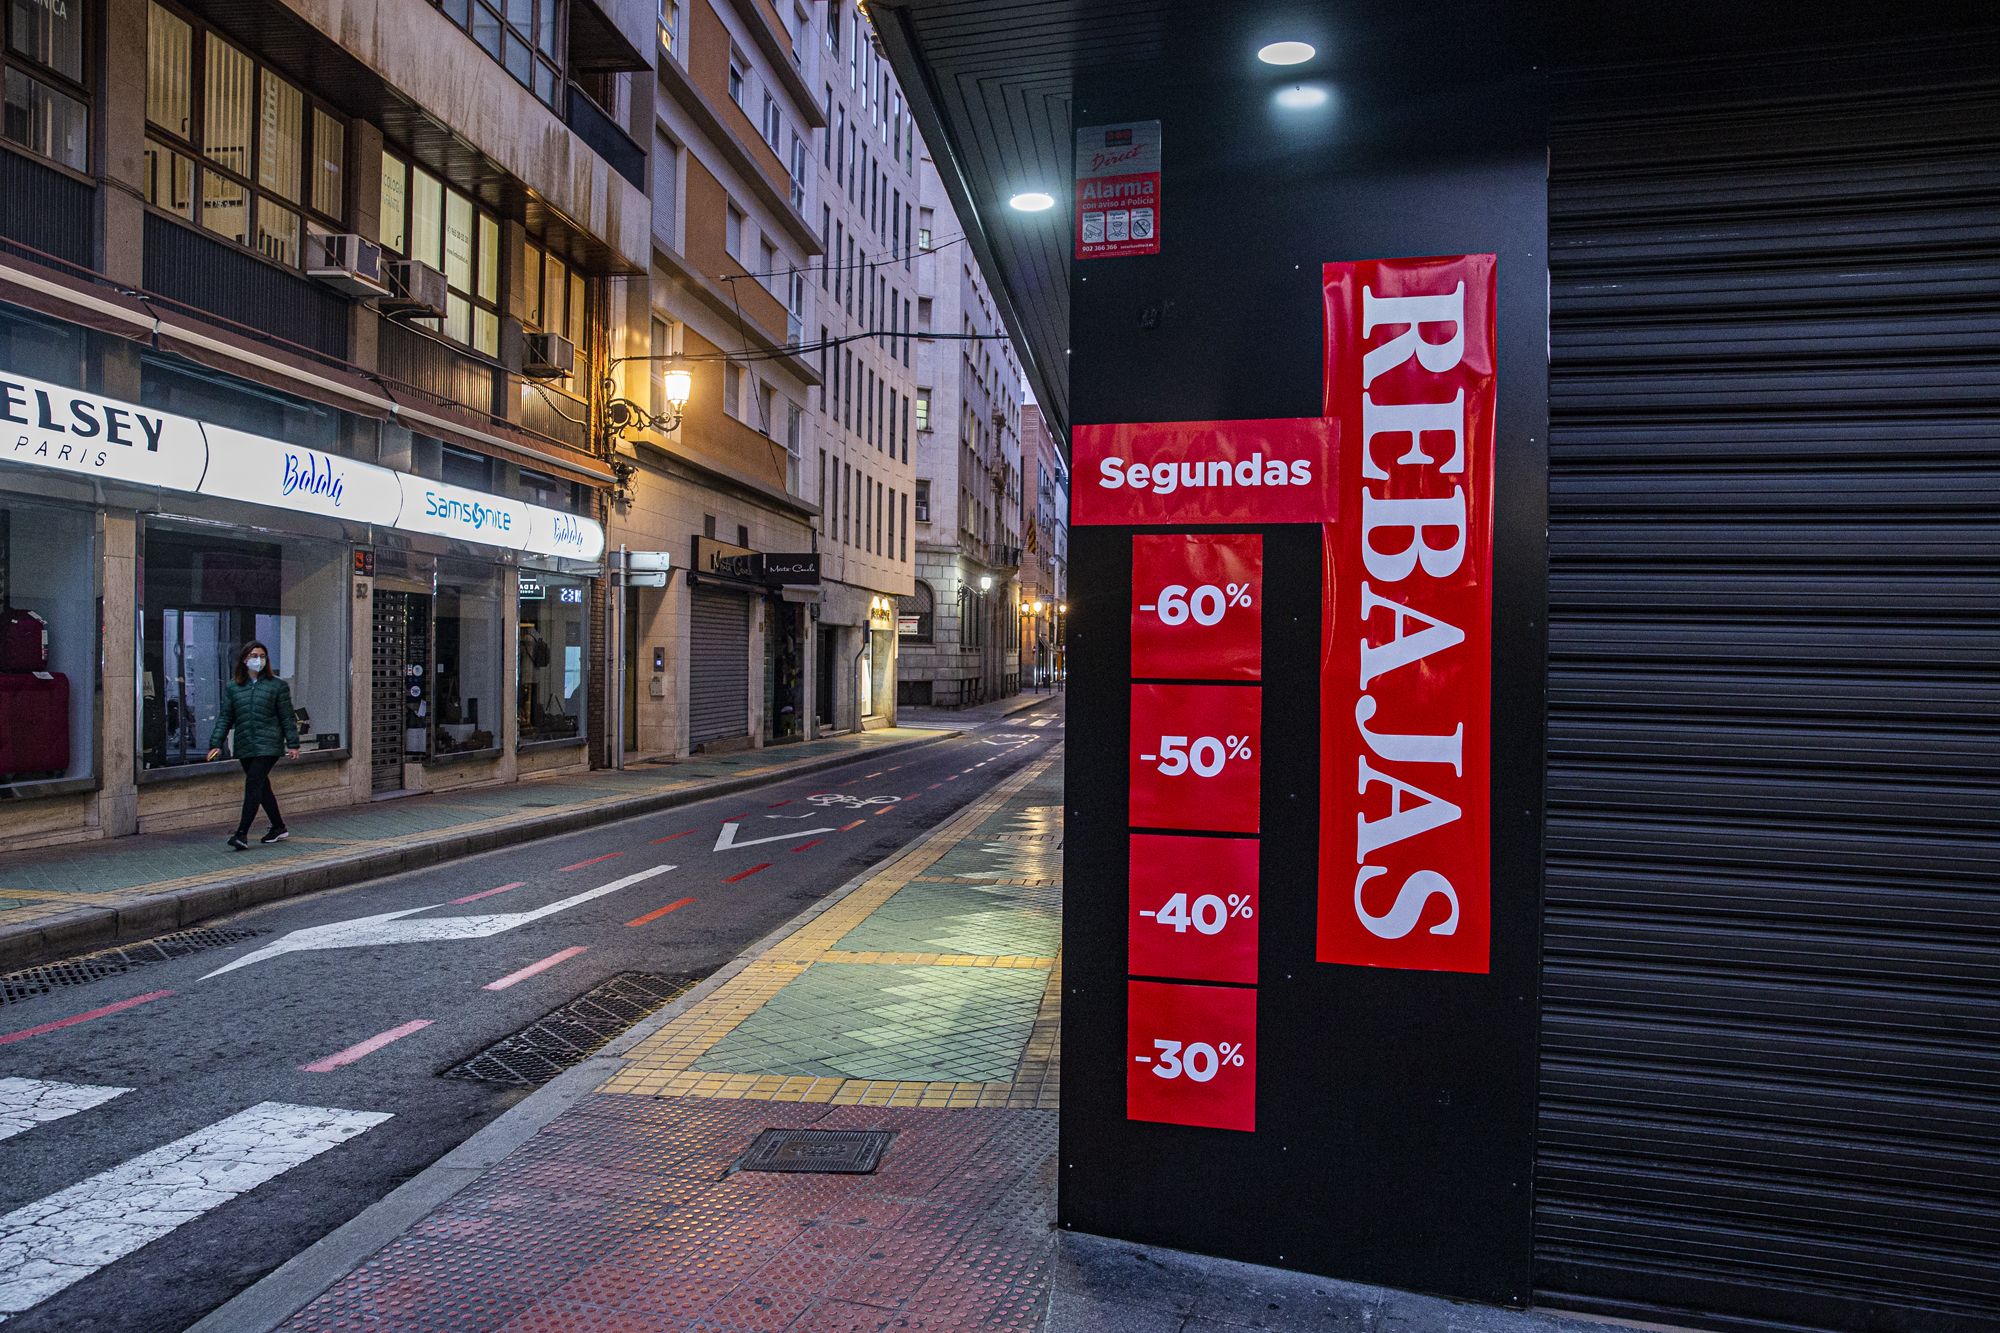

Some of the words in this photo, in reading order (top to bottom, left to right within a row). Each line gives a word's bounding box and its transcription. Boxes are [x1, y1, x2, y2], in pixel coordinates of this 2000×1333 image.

[1083, 181, 1153, 199] Alarma
[1098, 199, 1118, 208] aviso
[0, 381, 163, 452] ELSEY
[14, 435, 107, 467] PARIS
[1099, 453, 1312, 494] Segundas
[425, 491, 511, 531] Samsonite
[356, 583, 368, 599] 32
[1139, 583, 1252, 626] -60%
[1354, 280, 1465, 940] REBAJAS
[1140, 735, 1252, 778] -50%
[1139, 892, 1253, 935] -40%
[1135, 1038, 1245, 1083] -30%
